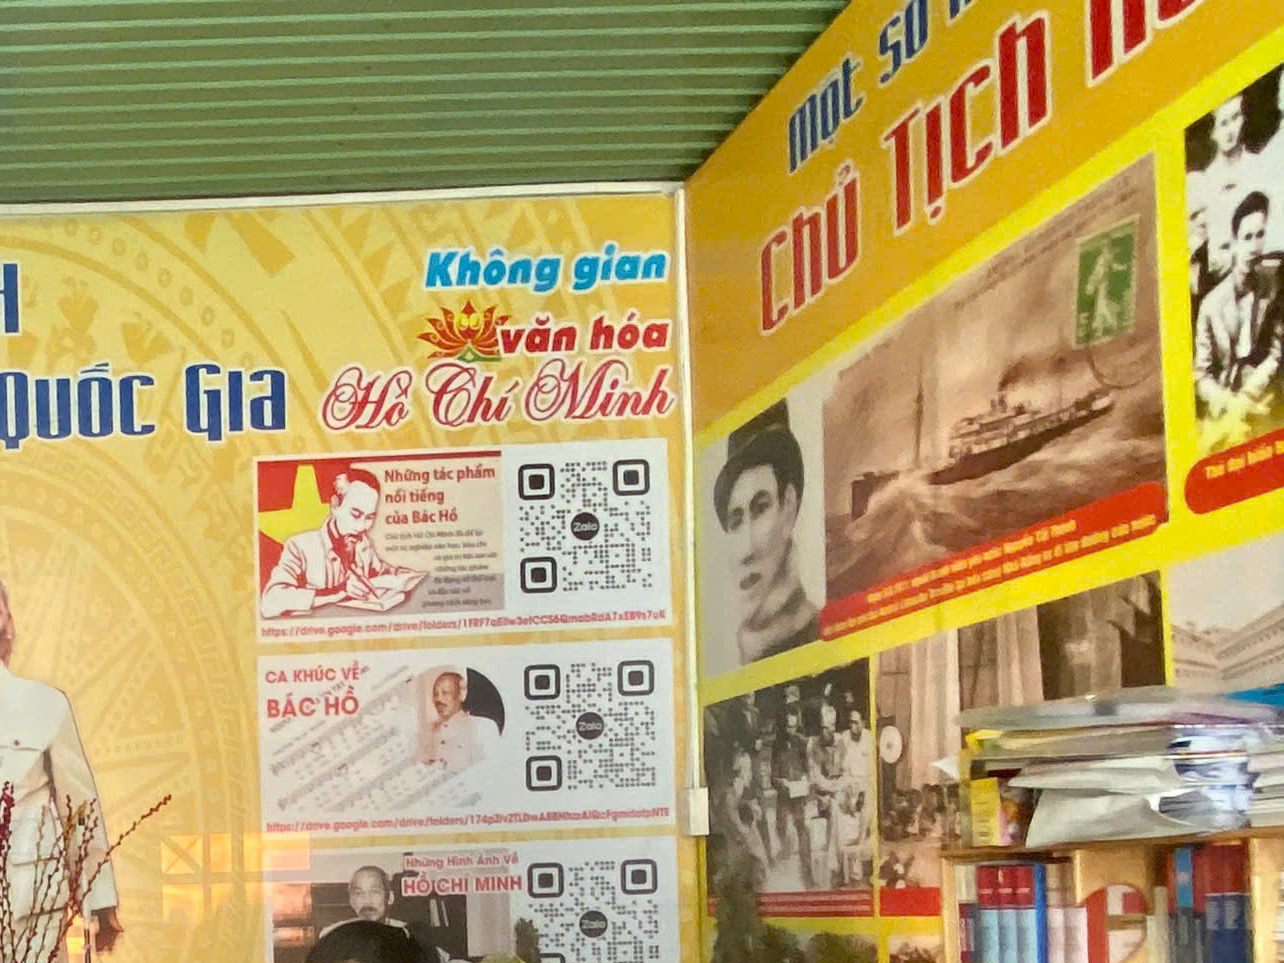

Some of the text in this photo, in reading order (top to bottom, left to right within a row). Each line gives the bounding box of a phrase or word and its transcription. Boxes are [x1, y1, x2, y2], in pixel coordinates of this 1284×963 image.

[425, 243, 667, 293] Không gian
[501, 311, 669, 353] văn hóa
[185, 364, 287, 442] Gia
[321, 358, 675, 430] Hồ Chí Minh
[383, 463, 496, 485] Những tác phẩm
[385, 486, 445, 505] nổi tiếng
[385, 507, 458, 525] của Bác Hồ
[265, 660, 360, 684] CA KHÚC VỀ
[267, 685, 359, 718] BÁC HỒ
[403, 871, 431, 894] HỒ
[476, 875, 522, 892] MINH
